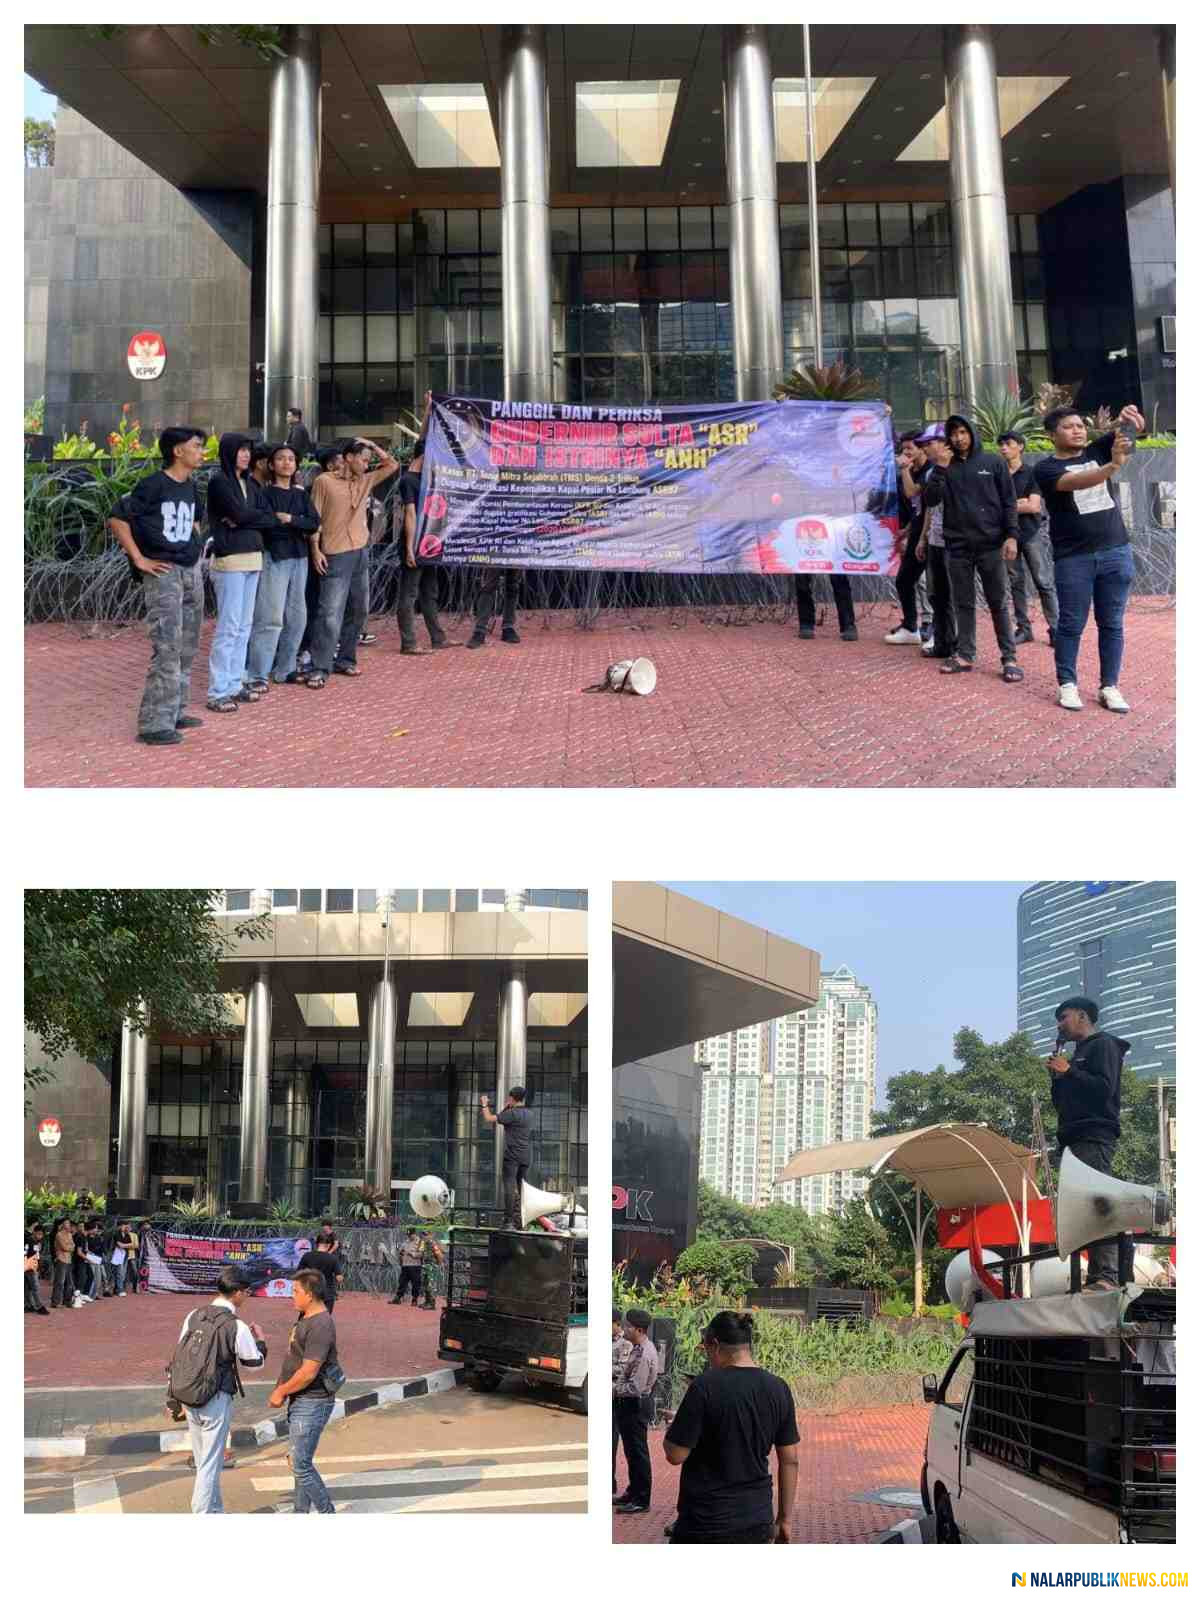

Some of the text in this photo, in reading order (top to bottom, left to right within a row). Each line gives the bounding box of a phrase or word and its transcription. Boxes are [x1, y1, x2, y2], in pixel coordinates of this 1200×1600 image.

[135, 367, 158, 376] KPK
[490, 400, 663, 422] PANGGIL DAN PERIKSA
[489, 419, 619, 446] GUBERNUR
[622, 422, 695, 447] SULTA
